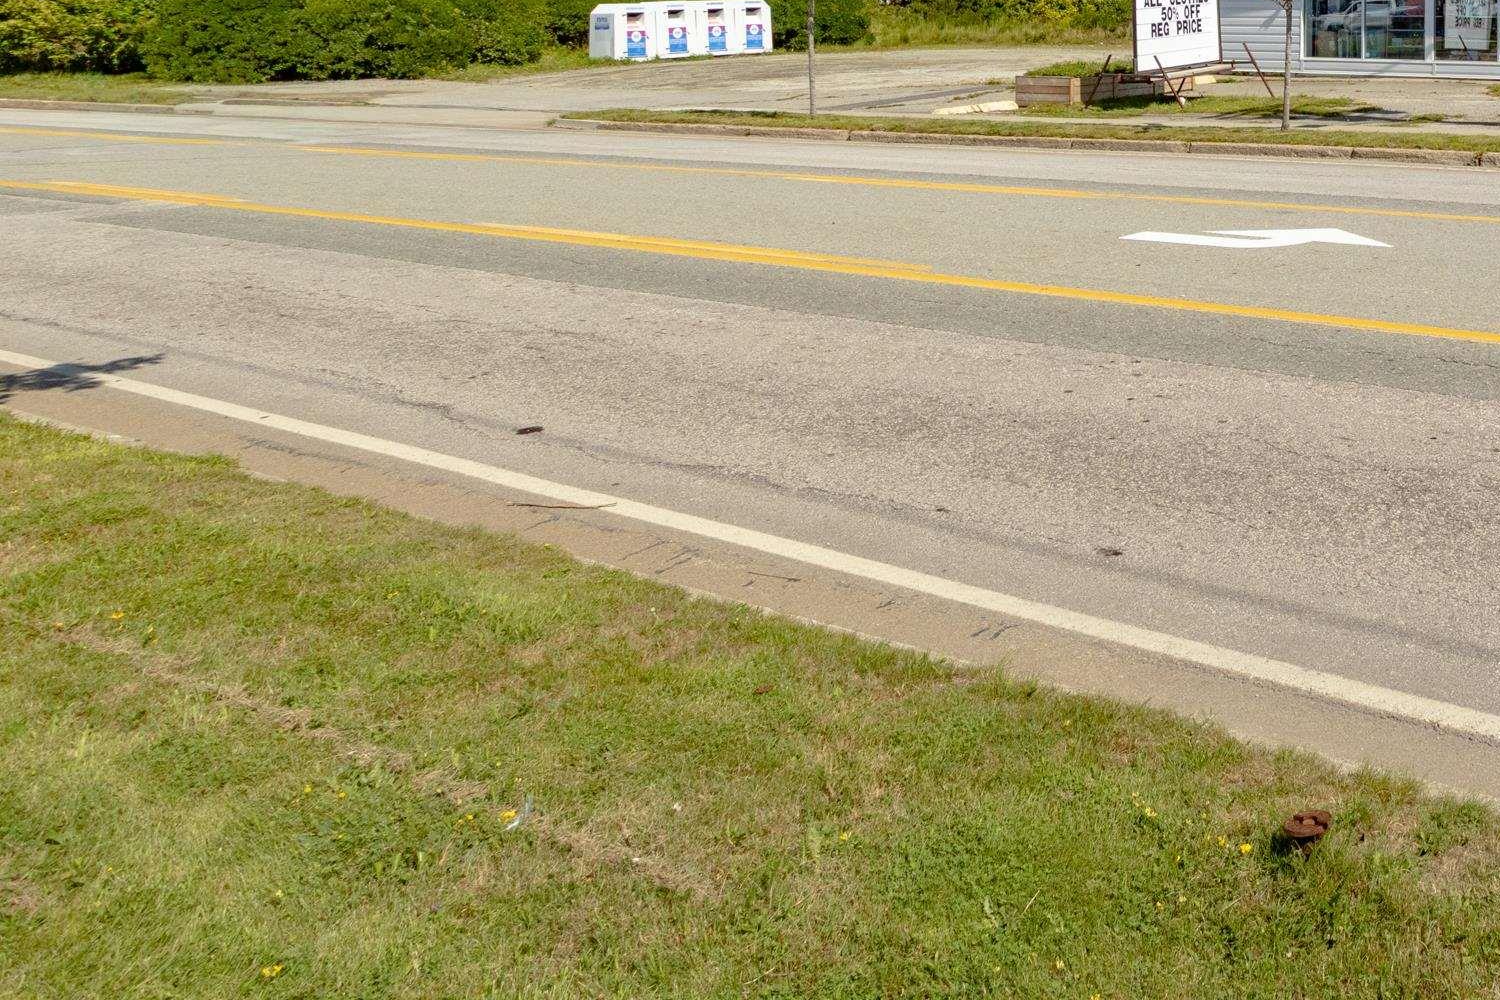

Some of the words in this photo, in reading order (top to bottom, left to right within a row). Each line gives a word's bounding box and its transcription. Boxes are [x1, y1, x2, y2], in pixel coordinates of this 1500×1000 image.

[1161, 6, 1180, 21] 50%
[1184, 4, 1201, 19] OFF
[1151, 22, 1170, 38] REG
[1176, 19, 1202, 35] PRICE
